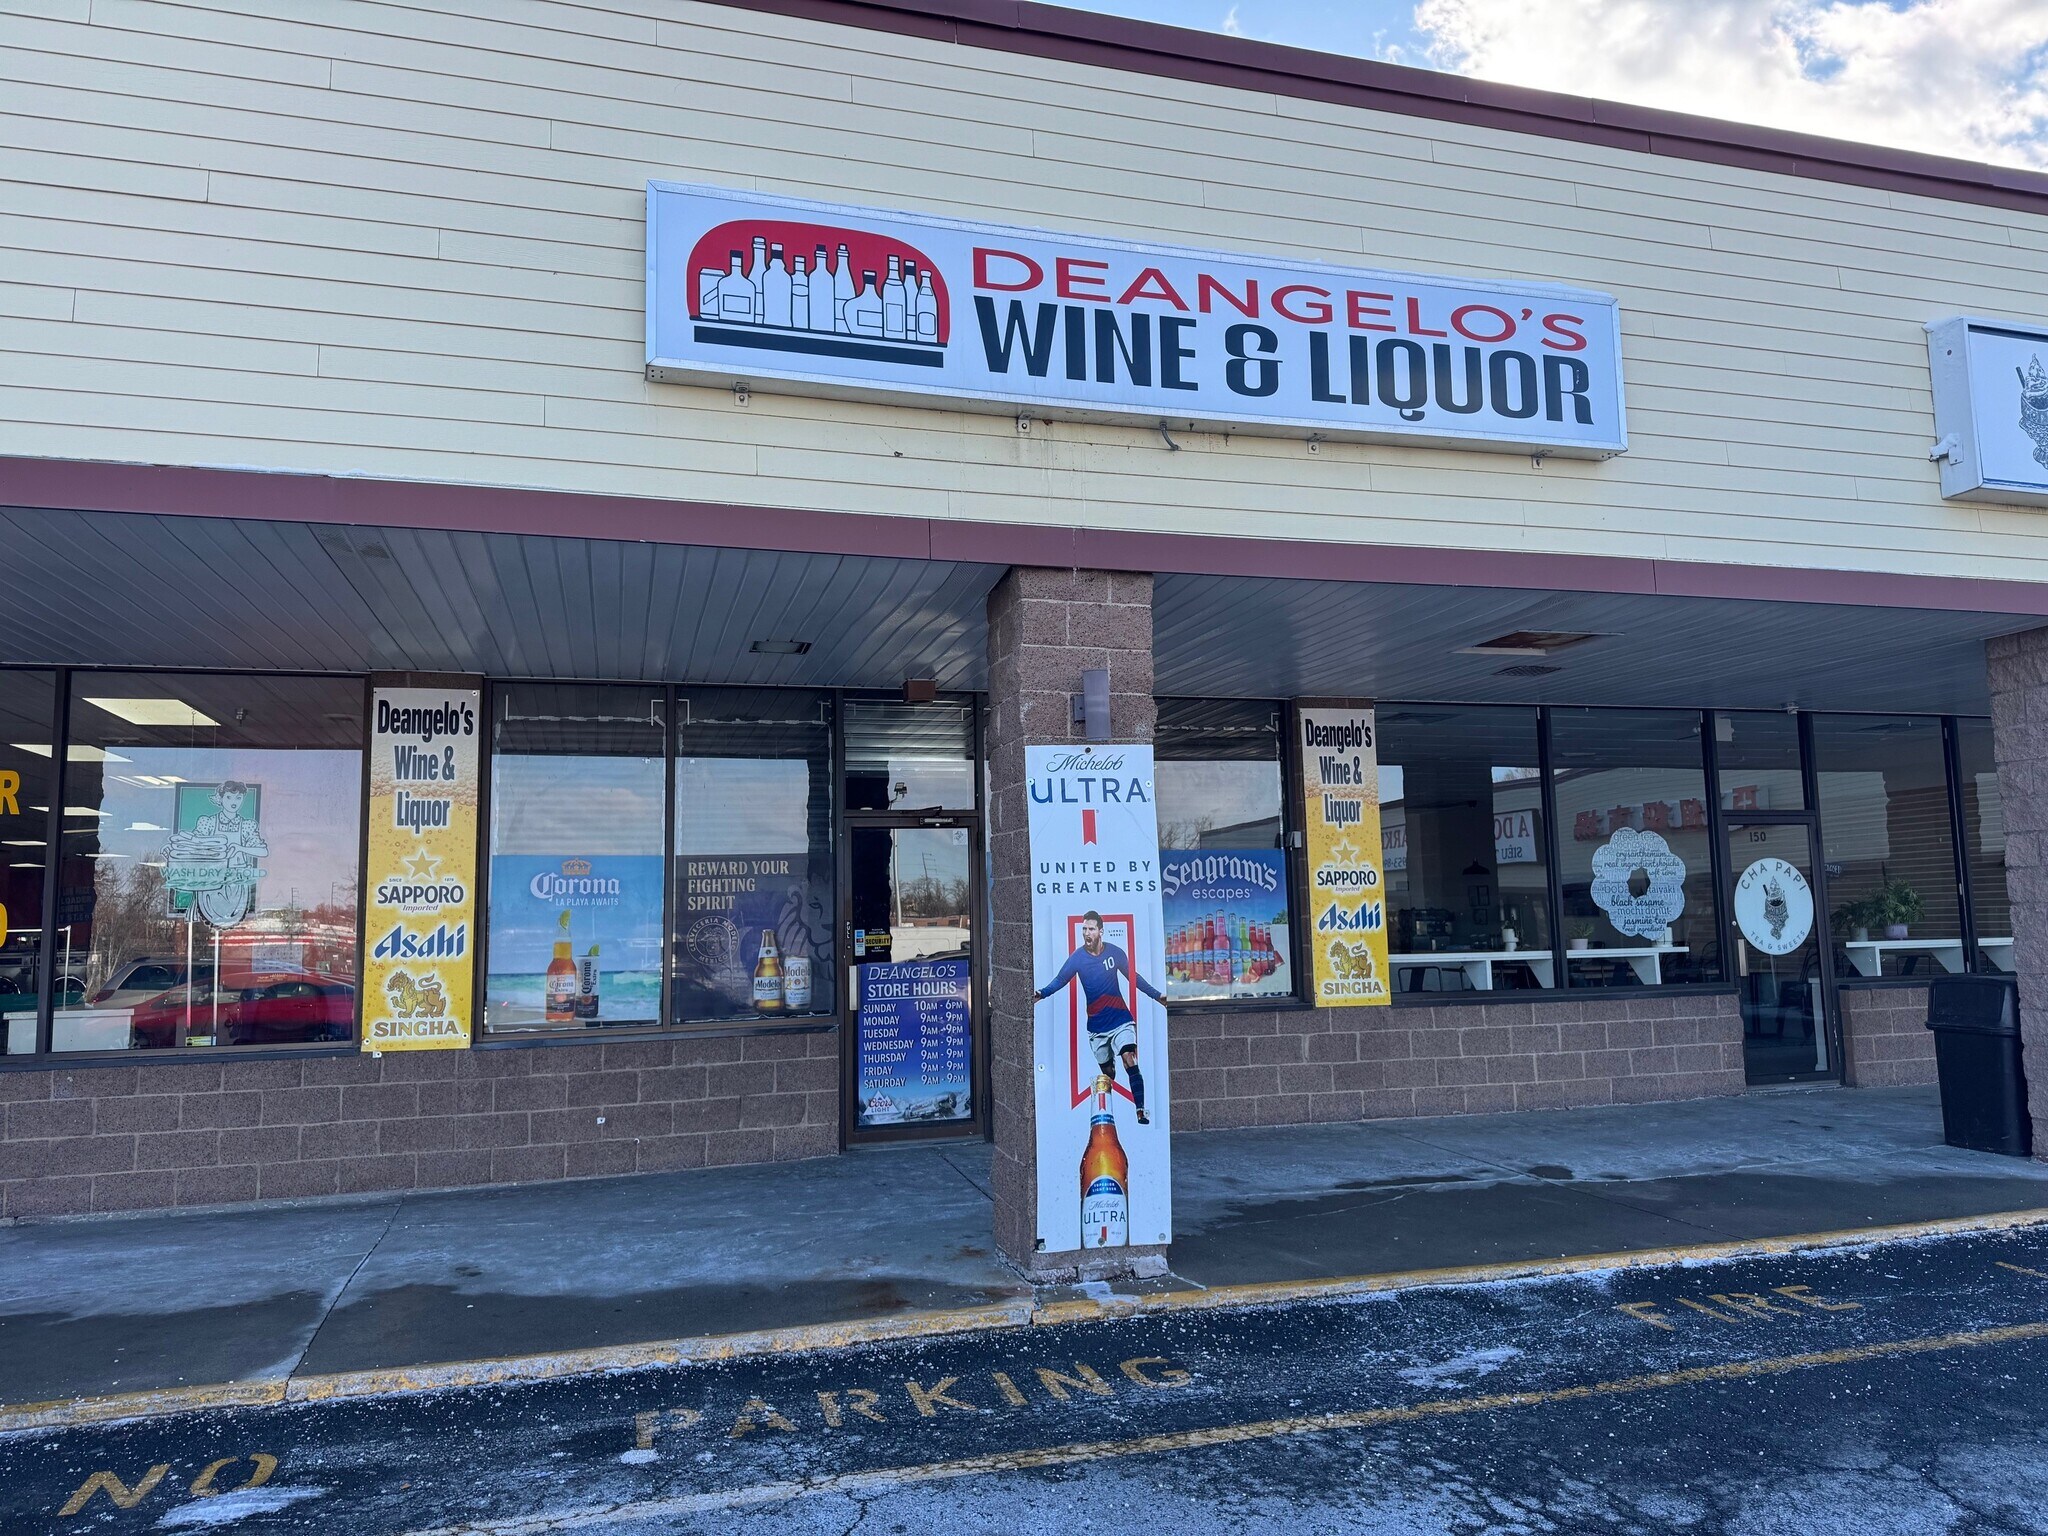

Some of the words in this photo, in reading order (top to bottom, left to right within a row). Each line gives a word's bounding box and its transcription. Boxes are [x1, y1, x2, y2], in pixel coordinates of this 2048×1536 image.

[973, 247, 1588, 352] DEANGELO'S
[973, 295, 1199, 392] WINE
[1225, 323, 1284, 398] &
[1310, 330, 1595, 424] LIQUOR
[378, 699, 474, 743] Deangelo's
[1305, 718, 1372, 754] Deangelo's
[394, 745, 439, 781] Wine
[442, 745, 455, 781] &
[1046, 753, 1126, 773] Michelob
[1319, 756, 1351, 785] Wine
[1353, 755, 1363, 785] &
[1031, 778, 1148, 803] ULTRA
[396, 791, 451, 834] Liquor
[1324, 793, 1361, 829] Liquor
[1749, 831, 1767, 843] 150
[160, 867, 194, 878] WASH
[201, 867, 222, 878] DRY
[236, 867, 268, 878] FOLD
[688, 861, 748, 876] REWARD
[751, 860, 789, 875] YOUR
[1040, 861, 1116, 874] UNITED
[1129, 860, 1151, 873] BY
[1162, 855, 1278, 896] Seagram's
[1317, 870, 1377, 886] SAPPORO
[1741, 863, 1768, 890] CHA
[1775, 861, 1807, 891] PAPI
[530, 872, 621, 902] Corona
[688, 878, 756, 894] FIGHTING
[1036, 880, 1157, 895] GREATNESS
[1335, 886, 1361, 894] Imported
[1605, 884, 1629, 894] boba
[377, 885, 464, 904] SAPPORO
[556, 898, 565, 906] LA
[566, 898, 589, 906] PLAYA
[591, 897, 619, 906] AWAITS
[1192, 888, 1251, 903] escapes
[1611, 894, 1634, 907] black
[1635, 899, 1664, 907] sesame
[402, 904, 439, 913] Imported
[688, 895, 735, 911] SPIRIT
[1617, 906, 1644, 915] mochi
[1318, 902, 1381, 931] Asahi
[1623, 916, 1653, 927] jasmine
[1654, 917, 1667, 925] tea
[374, 924, 465, 959] Asahi
[1750, 931, 1764, 946] TEA
[1777, 930, 1806, 951] SWEETS
[1102, 956, 1115, 971] 10
[581, 961, 592, 994] Corona
[868, 983, 909, 998] STORE
[913, 981, 957, 997] HOURS
[1323, 981, 1383, 995] SINGHA
[863, 1003, 896, 1014] SUNDAY
[914, 1000, 938, 1011] 10AM
[945, 999, 963, 1010] 6PM
[863, 1015, 900, 1026] MONDAY
[920, 1013, 938, 1023] 9AM
[945, 1011, 963, 1022] 9PM
[374, 1020, 459, 1037] SINGHA
[863, 1028, 899, 1038] TUESDAY
[920, 1025, 938, 1035] 9AM
[945, 1023, 963, 1034] 9PM
[864, 1040, 914, 1051] WEDNESDAY
[920, 1037, 938, 1048] 9AM
[946, 1036, 963, 1046] 9PM
[864, 1052, 907, 1064] THURSDAY
[921, 1049, 938, 1060] 9AM
[946, 1048, 964, 1059] 9PM
[864, 1065, 893, 1076] FRIDAY
[921, 1062, 939, 1072] 9AM
[946, 1061, 964, 1071] 9PM
[864, 1077, 906, 1089] SATURDAY
[921, 1074, 939, 1085] 9AM
[946, 1073, 965, 1083] 9PM
[1084, 1210, 1127, 1225] ULTRA
[57, 1453, 278, 1516] NO
[633, 1357, 1193, 1450] PARKING
[1617, 1285, 1862, 1332] FIRE
